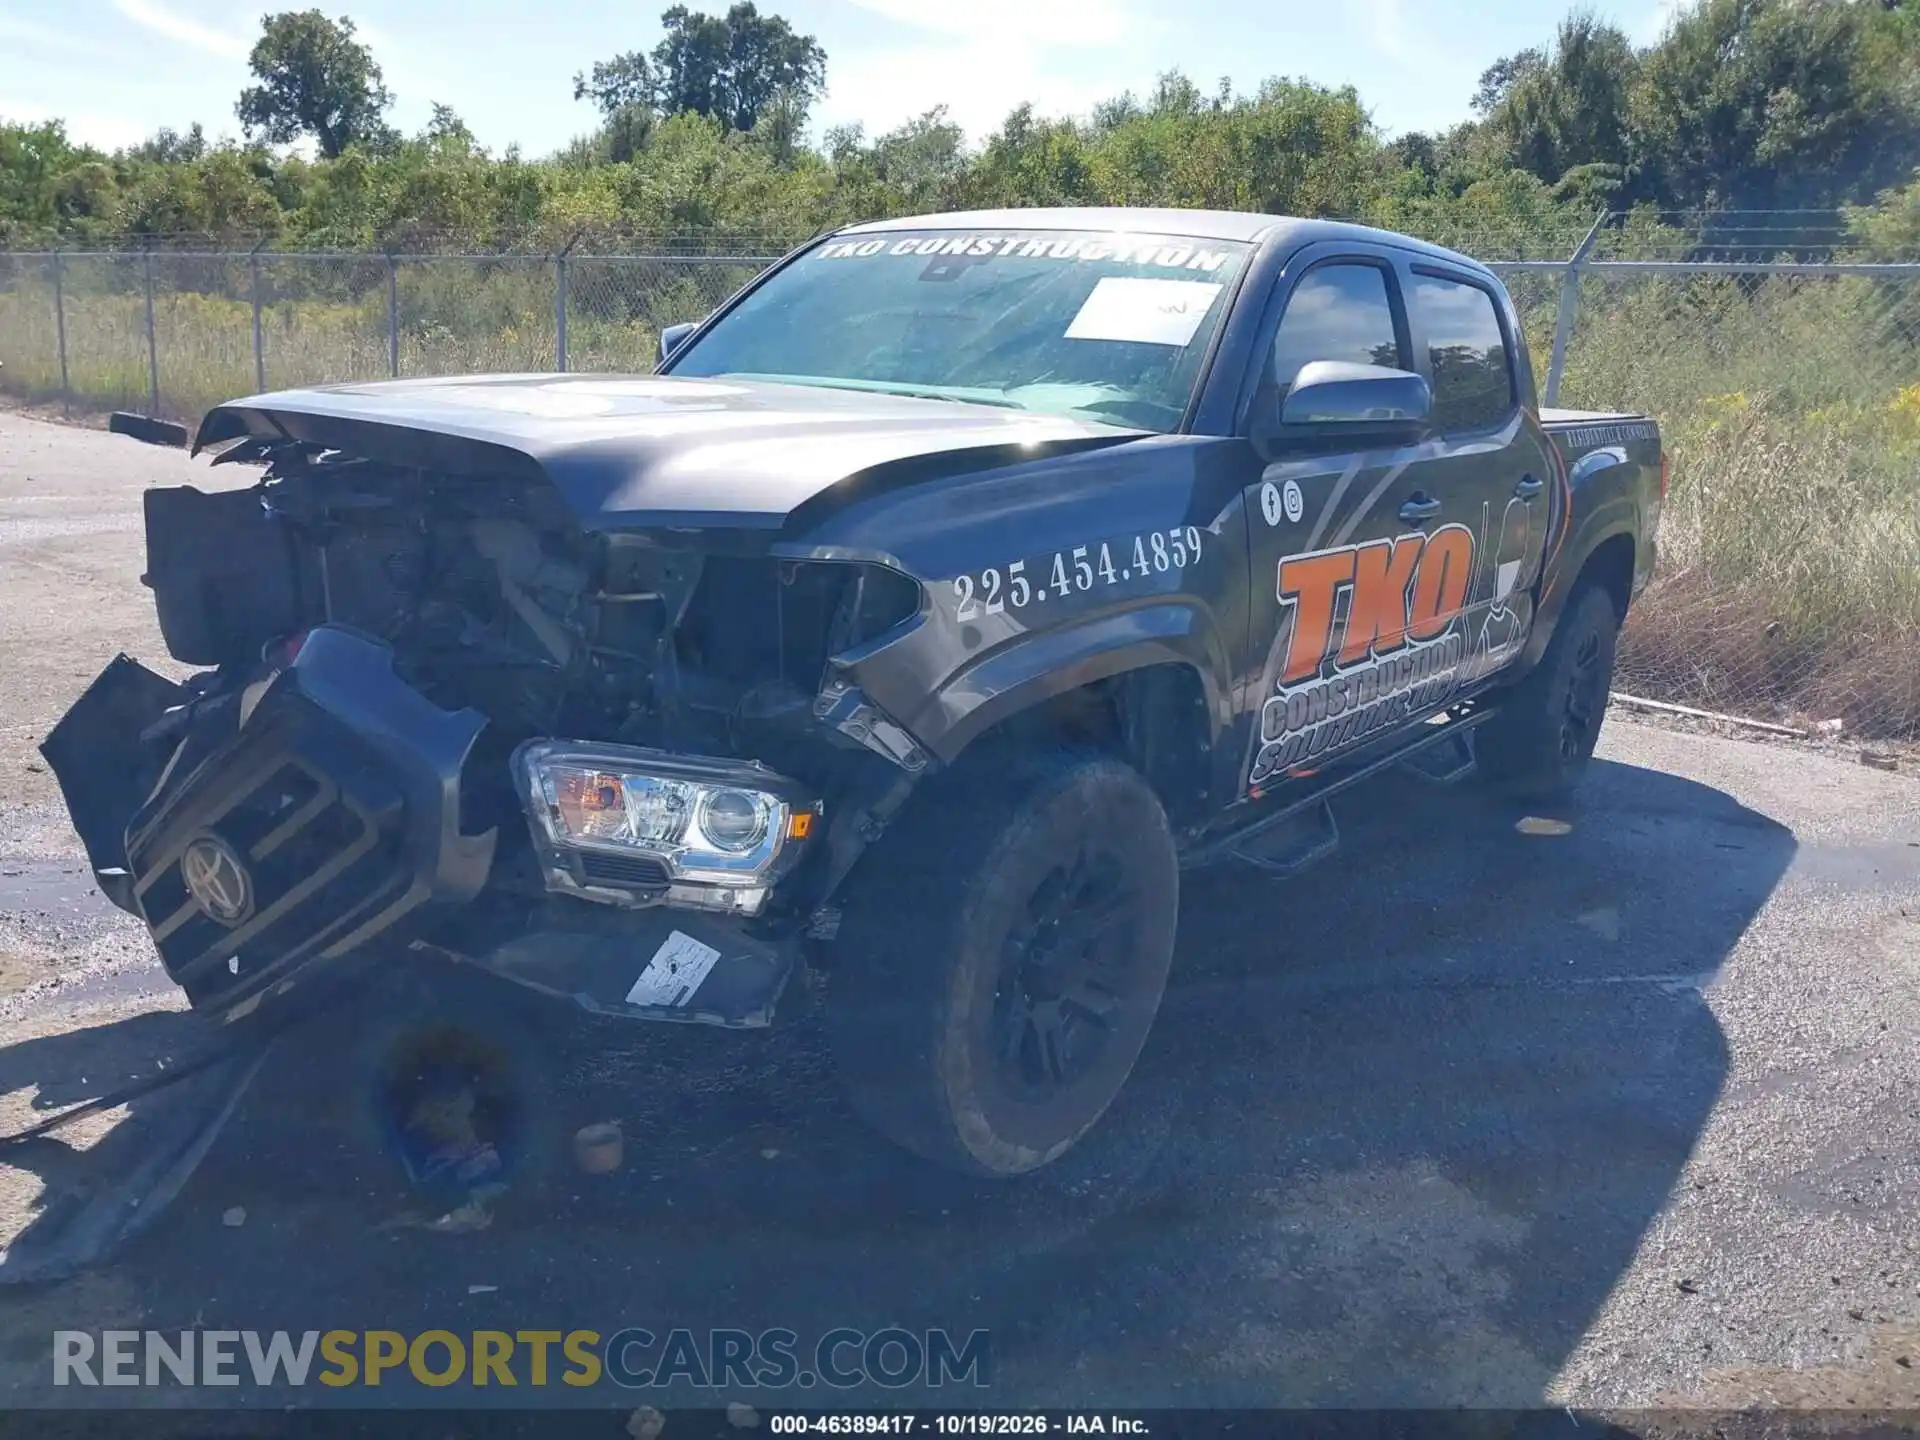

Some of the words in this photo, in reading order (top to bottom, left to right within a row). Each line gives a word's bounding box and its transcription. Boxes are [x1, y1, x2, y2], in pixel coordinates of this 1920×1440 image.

[816, 239, 888, 260] TKO
[954, 526, 1202, 623] 225.454.4859
[1278, 523, 1475, 692] TKO
[1262, 635, 1460, 741] CONSTRUCTION
